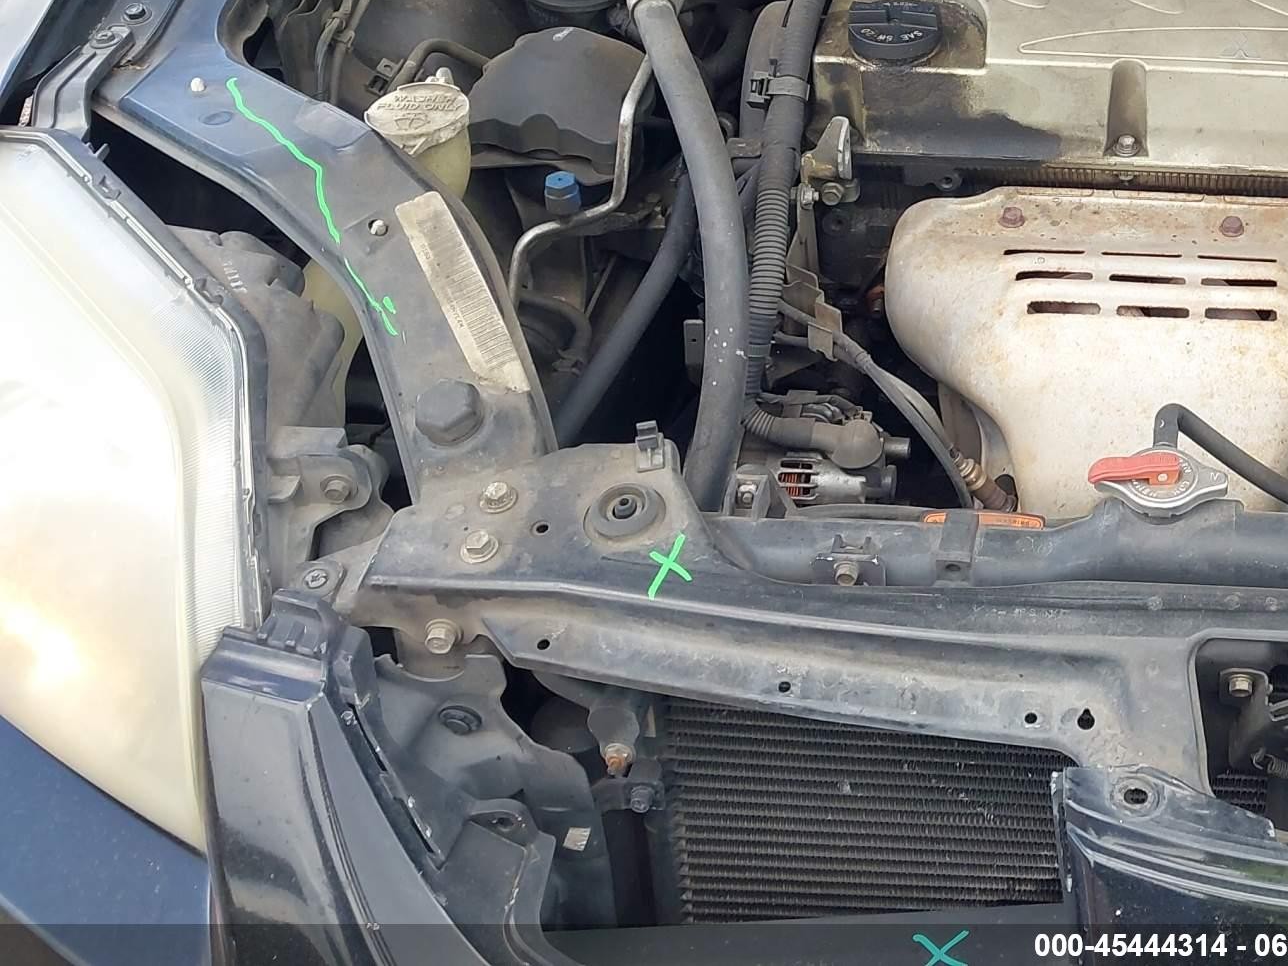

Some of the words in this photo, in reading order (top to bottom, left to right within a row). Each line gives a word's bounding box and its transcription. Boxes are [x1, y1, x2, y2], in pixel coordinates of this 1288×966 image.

[900, 30, 923, 41] SAE
[376, 102, 419, 111] FLUID
[423, 103, 463, 112] ONLY
